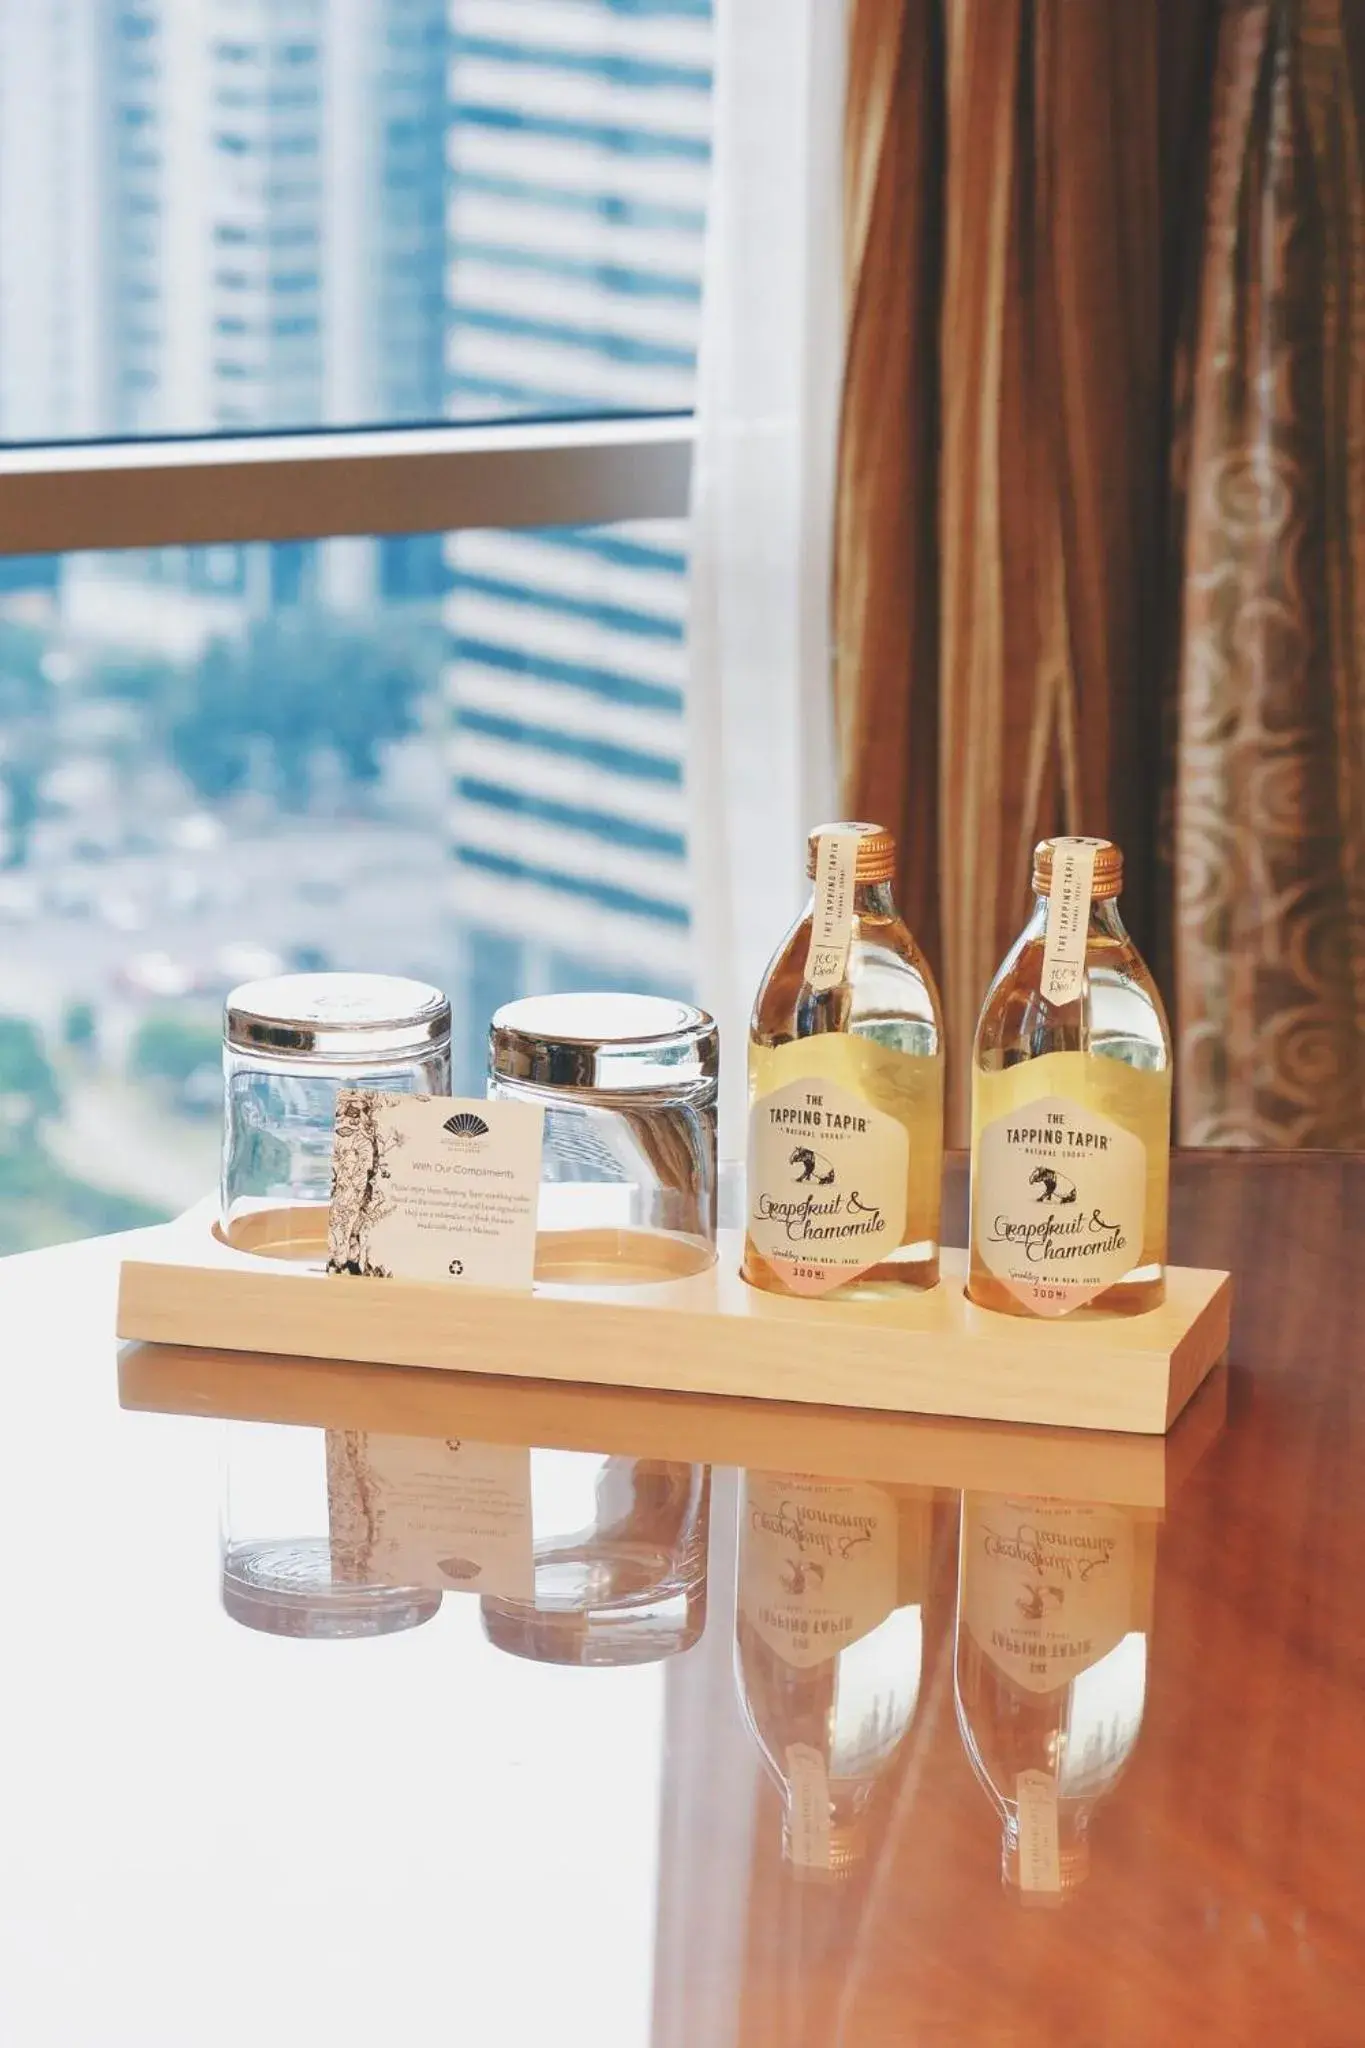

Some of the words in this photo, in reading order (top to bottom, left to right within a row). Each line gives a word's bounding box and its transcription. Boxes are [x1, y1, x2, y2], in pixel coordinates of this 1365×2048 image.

[806, 1094, 824, 1106] THE
[769, 1108, 821, 1126] TAPPING
[825, 1112, 866, 1133] TAPIR
[1047, 1113, 1065, 1124] THE
[1007, 1128, 1063, 1145] TAPPING
[1067, 1131, 1108, 1151] TAPIR
[411, 1161, 433, 1173] With
[434, 1163, 451, 1174] Our
[453, 1165, 514, 1179] Compliments
[754, 1193, 845, 1223] Grapefruit
[846, 1191, 880, 1214] &
[786, 1211, 886, 1241] Chamomile
[987, 1213, 1083, 1243] Grapefruit
[1088, 1209, 1121, 1233] &
[1018, 1229, 1126, 1262] Chamomile
